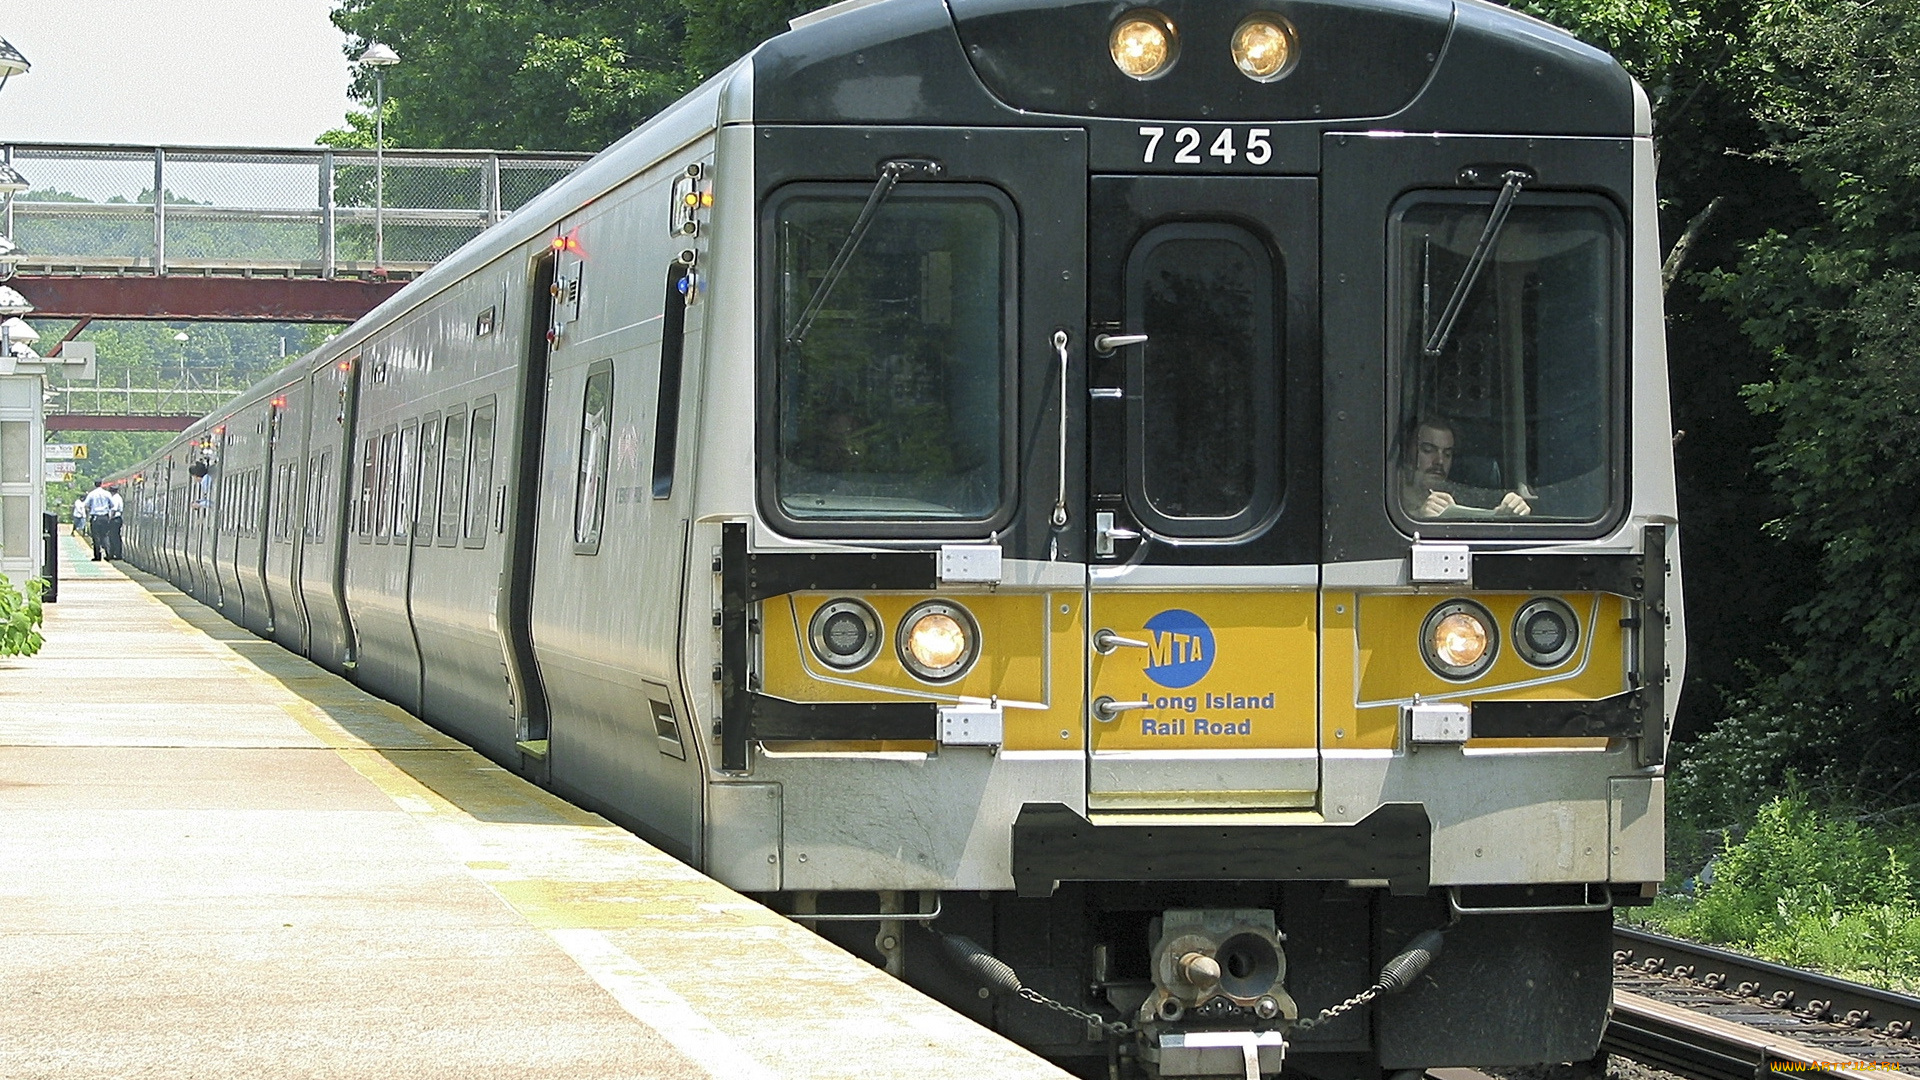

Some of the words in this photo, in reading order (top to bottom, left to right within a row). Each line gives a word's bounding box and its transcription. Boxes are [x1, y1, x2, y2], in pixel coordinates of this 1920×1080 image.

[1139, 127, 1272, 165] 7245
[1143, 628, 1202, 669] MTA
[1141, 692, 1198, 713] Long
[1205, 692, 1275, 709] Island
[1141, 718, 1186, 735] Rail
[1194, 718, 1251, 735] Road
